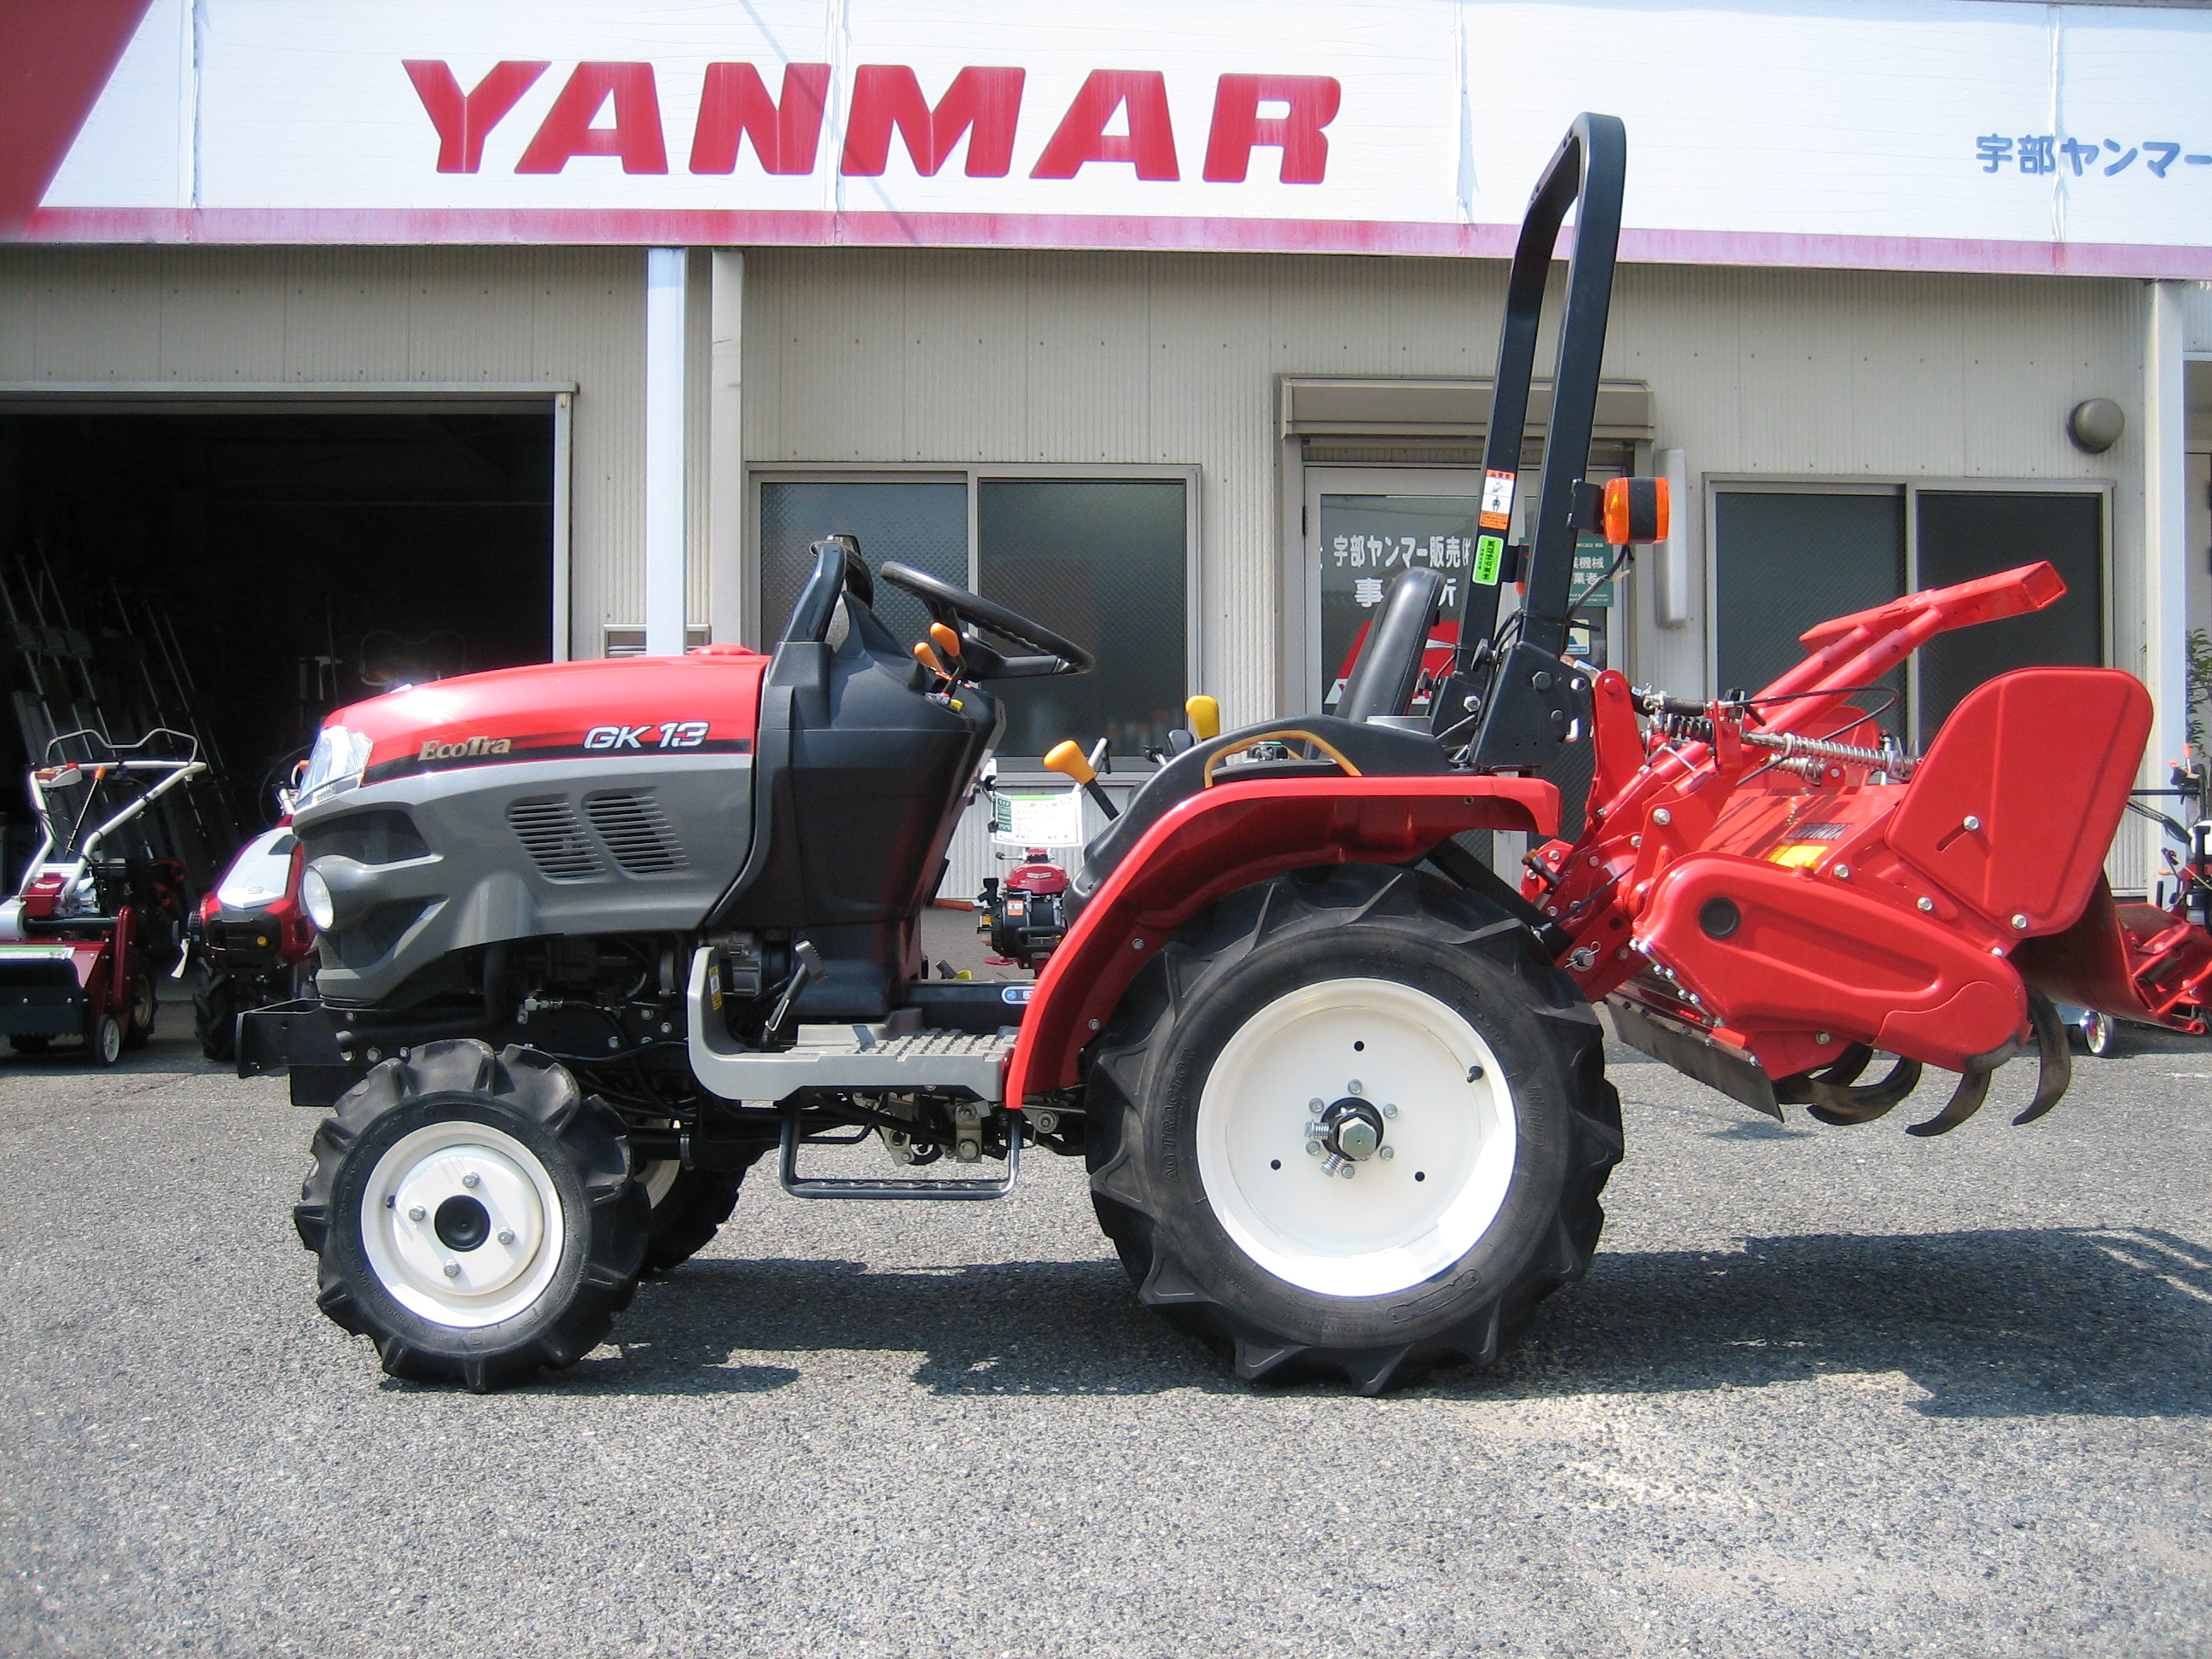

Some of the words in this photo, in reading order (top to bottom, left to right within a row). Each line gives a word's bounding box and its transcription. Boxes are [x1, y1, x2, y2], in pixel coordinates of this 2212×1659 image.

[401, 60, 1341, 184] YANMAR
[1976, 133, 2212, 178] 宇部ヤンマー
[417, 736, 512, 761] EcoTra
[582, 725, 651, 749] GK
[658, 721, 711, 748] 13
[1161, 1047, 1196, 1150] TRACTOR
